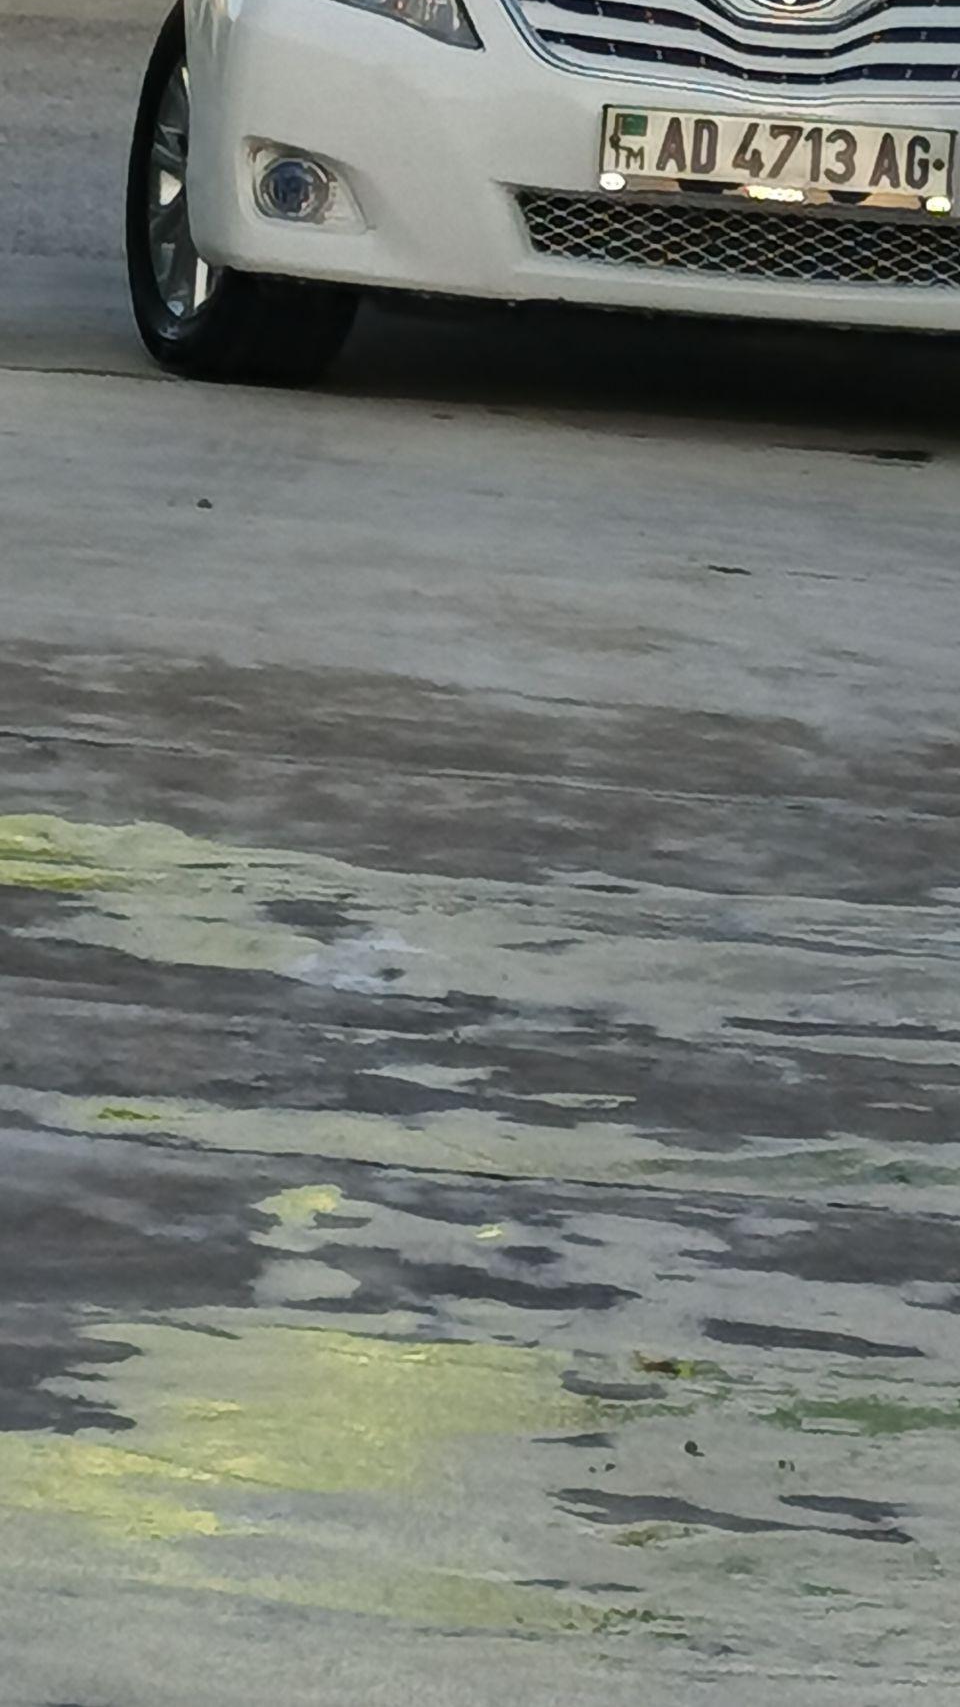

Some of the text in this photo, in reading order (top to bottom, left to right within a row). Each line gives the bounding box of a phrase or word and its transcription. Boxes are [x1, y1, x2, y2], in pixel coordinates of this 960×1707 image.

[655, 116, 719, 175] AD
[732, 122, 857, 184] 4713
[868, 132, 931, 189] AG
